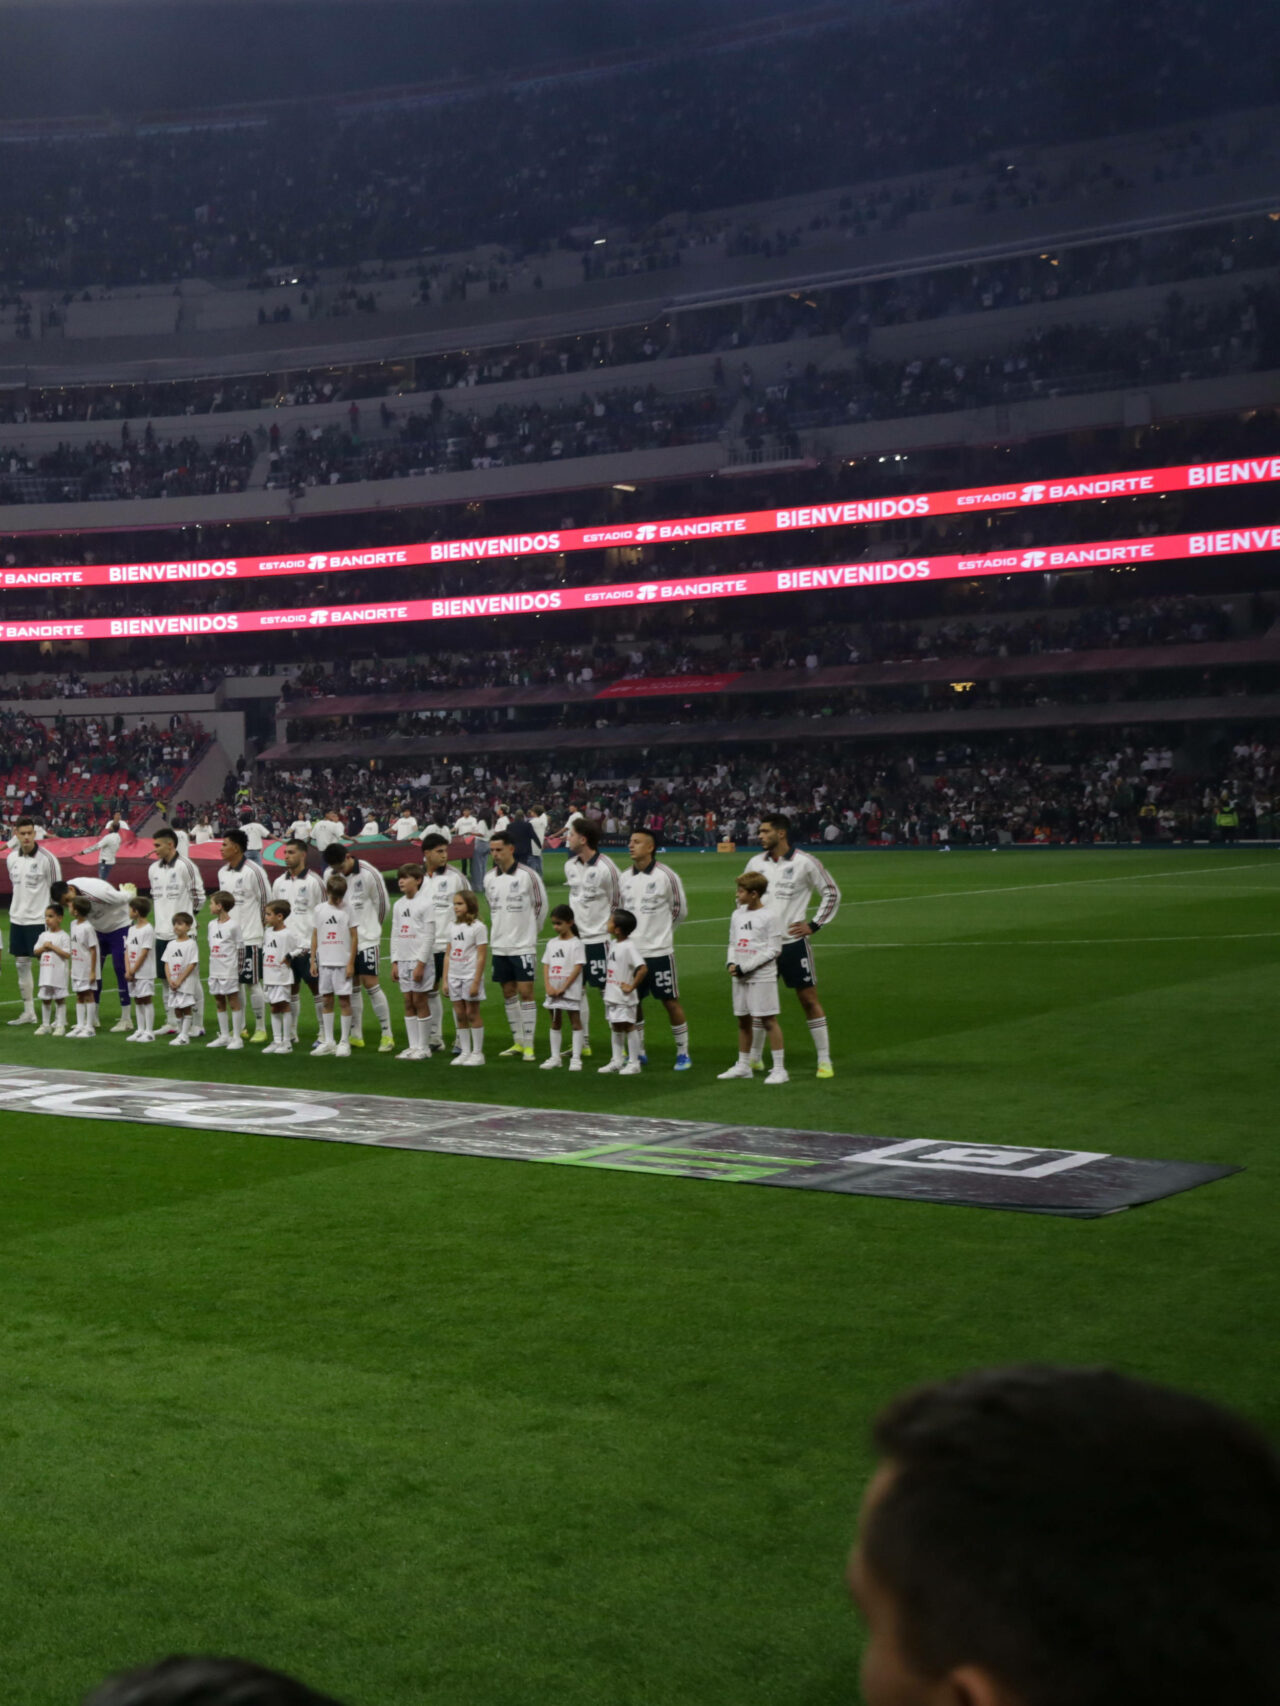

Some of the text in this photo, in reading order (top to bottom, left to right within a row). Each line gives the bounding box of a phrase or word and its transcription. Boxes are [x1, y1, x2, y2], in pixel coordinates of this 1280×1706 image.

[957, 477, 1153, 505] ESTADIO BANORTE
[776, 497, 930, 528] BIENVENIDOS
[583, 519, 747, 542] ESTADIO BANORTE
[430, 534, 561, 560] BIENVENIDOS
[957, 544, 1155, 570] ESTADIO BANORTE
[258, 551, 407, 570] ESTADIO BANORTE
[4, 572, 84, 584] BANORTE
[108, 561, 238, 582] BIENVENIDOS
[777, 561, 931, 589] BIENVENIDOS
[583, 580, 748, 601] ESTADIO BANORTE
[431, 592, 562, 617] BIENVENIDOS
[109, 615, 240, 635] BIENVENIDOS
[259, 607, 409, 625] ESTADIO BANORTE
[5, 624, 85, 638] BANORTE
[589, 959, 607, 975] 24
[654, 970, 673, 987] 25
